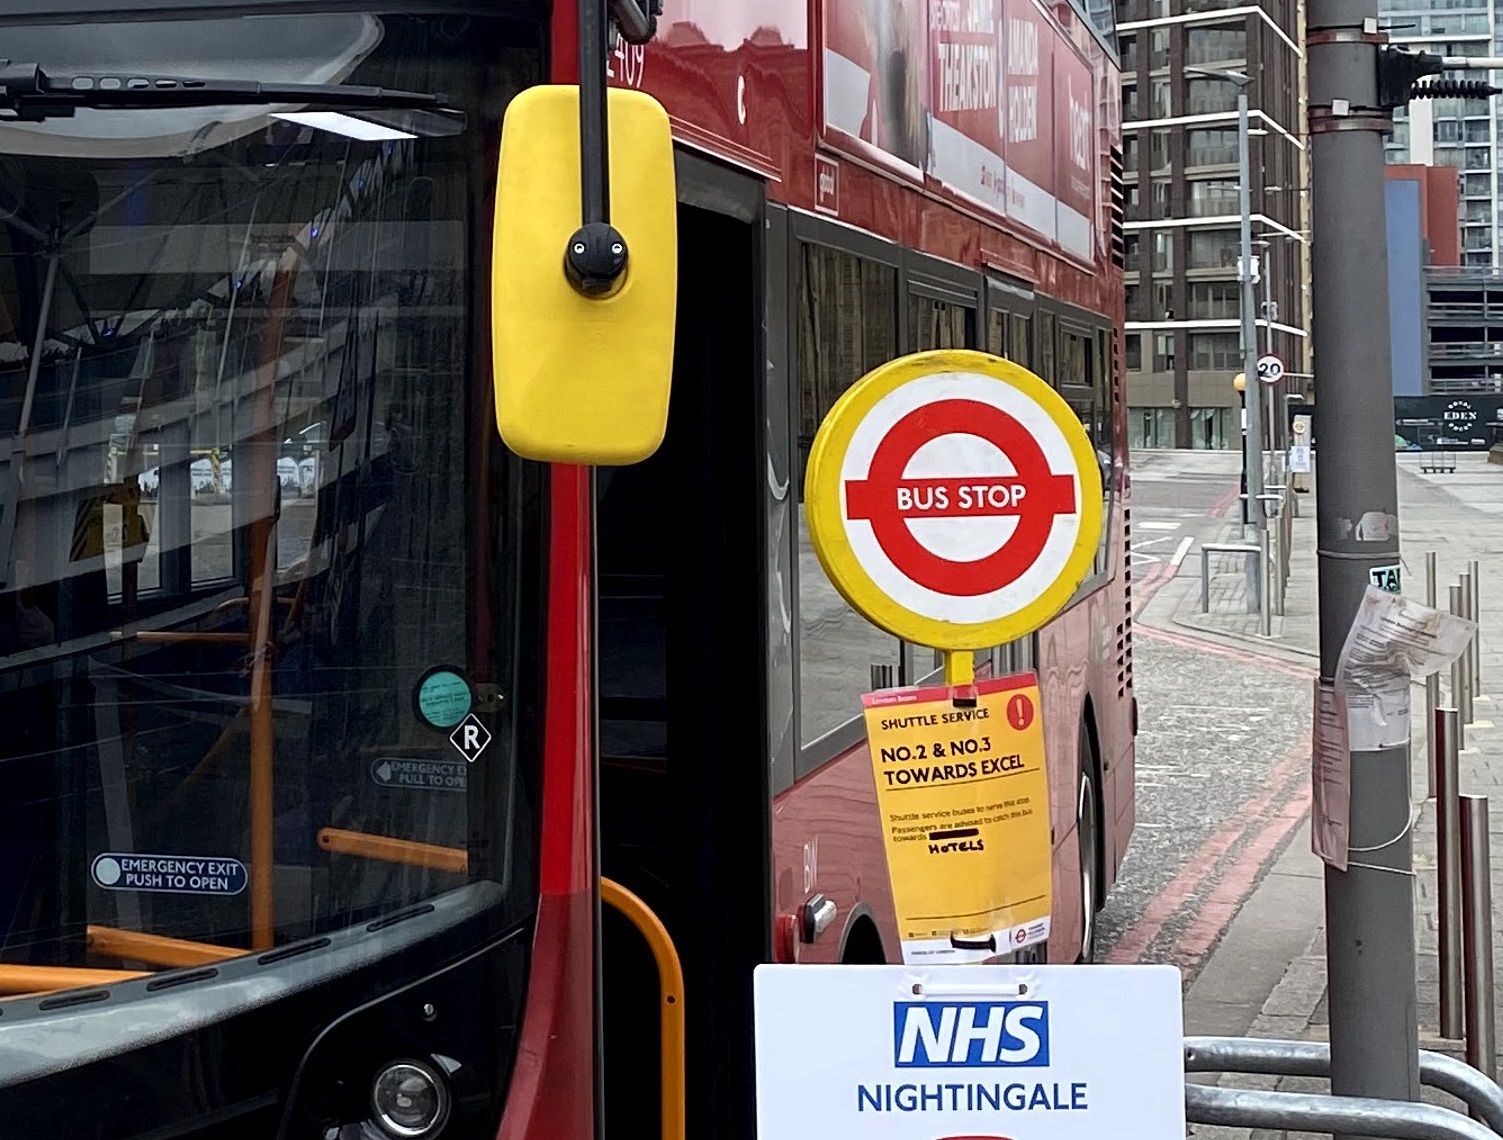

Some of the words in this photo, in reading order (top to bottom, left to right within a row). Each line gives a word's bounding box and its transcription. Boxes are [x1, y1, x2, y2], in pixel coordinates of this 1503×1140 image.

[1259, 362, 1281, 378] 20
[1444, 411, 1478, 420] EDEN
[896, 486, 949, 511] BUS
[958, 484, 1027, 509] STOP
[881, 715, 938, 731] SHUTTLE
[942, 708, 990, 724] SERVICE
[464, 724, 480, 750] R
[881, 744, 927, 763] NO.2
[932, 743, 946, 758] &
[950, 737, 991, 756] NO.3
[445, 776, 467, 787] OPE
[884, 762, 978, 785] TOWARDS
[982, 754, 1025, 775] EXCEL
[121, 859, 205, 875] EMERGENCY
[208, 862, 239, 876] EXIT
[126, 873, 162, 887] PUSH
[166, 875, 186, 888] TO
[190, 876, 229, 890] OPEN
[898, 1005, 1044, 1063] NHS
[857, 1082, 1088, 1112] NIGHTINGALE
